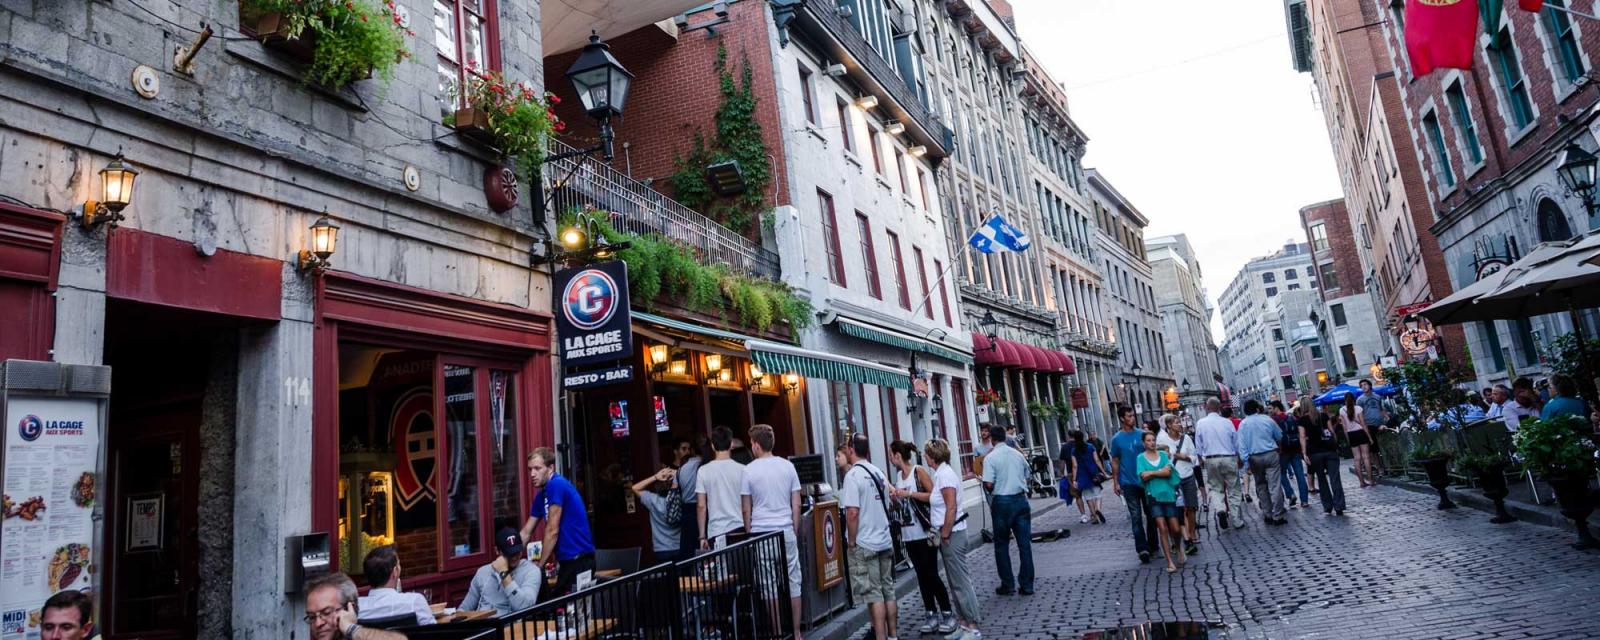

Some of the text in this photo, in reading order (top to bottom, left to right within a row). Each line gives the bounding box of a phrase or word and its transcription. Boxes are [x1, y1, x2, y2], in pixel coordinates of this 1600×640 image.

[565, 330, 622, 350] LA CAGE
[566, 343, 622, 359] AUX SPORTS
[564, 369, 629, 387] RESTO BAR
[284, 376, 311, 405] 114
[46, 420, 58, 429] LA
[59, 420, 83, 429] CAGE
[3, 610, 26, 622] MIDI
